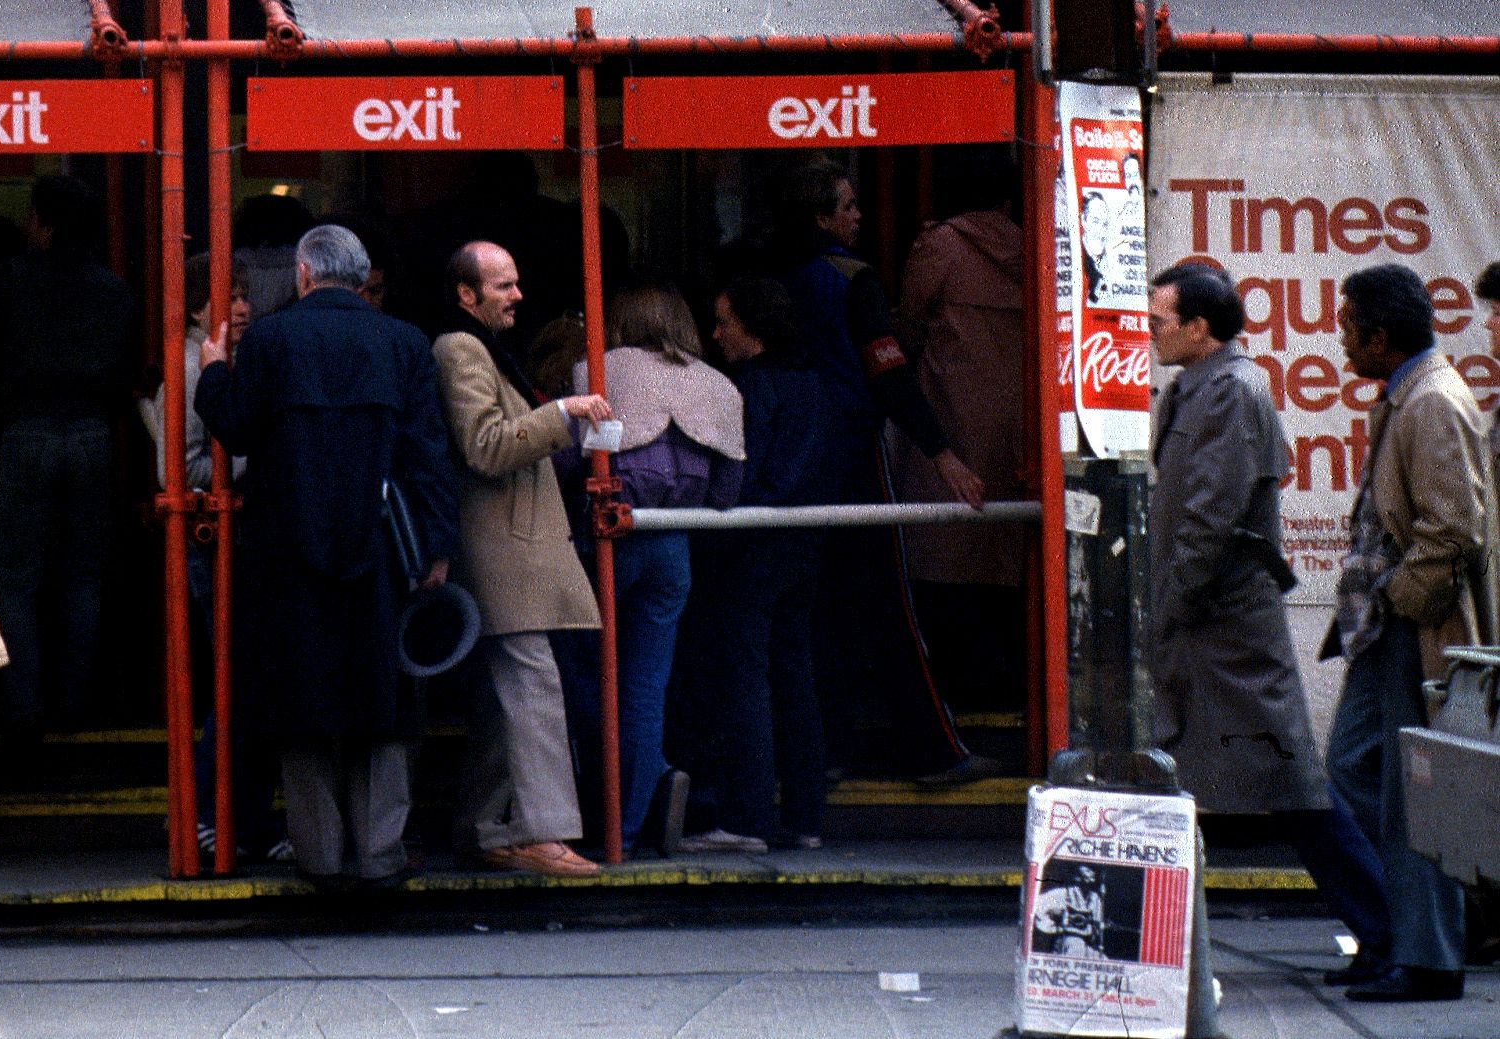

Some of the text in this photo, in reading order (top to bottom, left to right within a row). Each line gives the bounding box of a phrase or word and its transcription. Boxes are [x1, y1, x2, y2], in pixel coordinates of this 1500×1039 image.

[353, 88, 460, 141] exit
[769, 86, 876, 138] exit
[1168, 178, 1433, 255] Times
